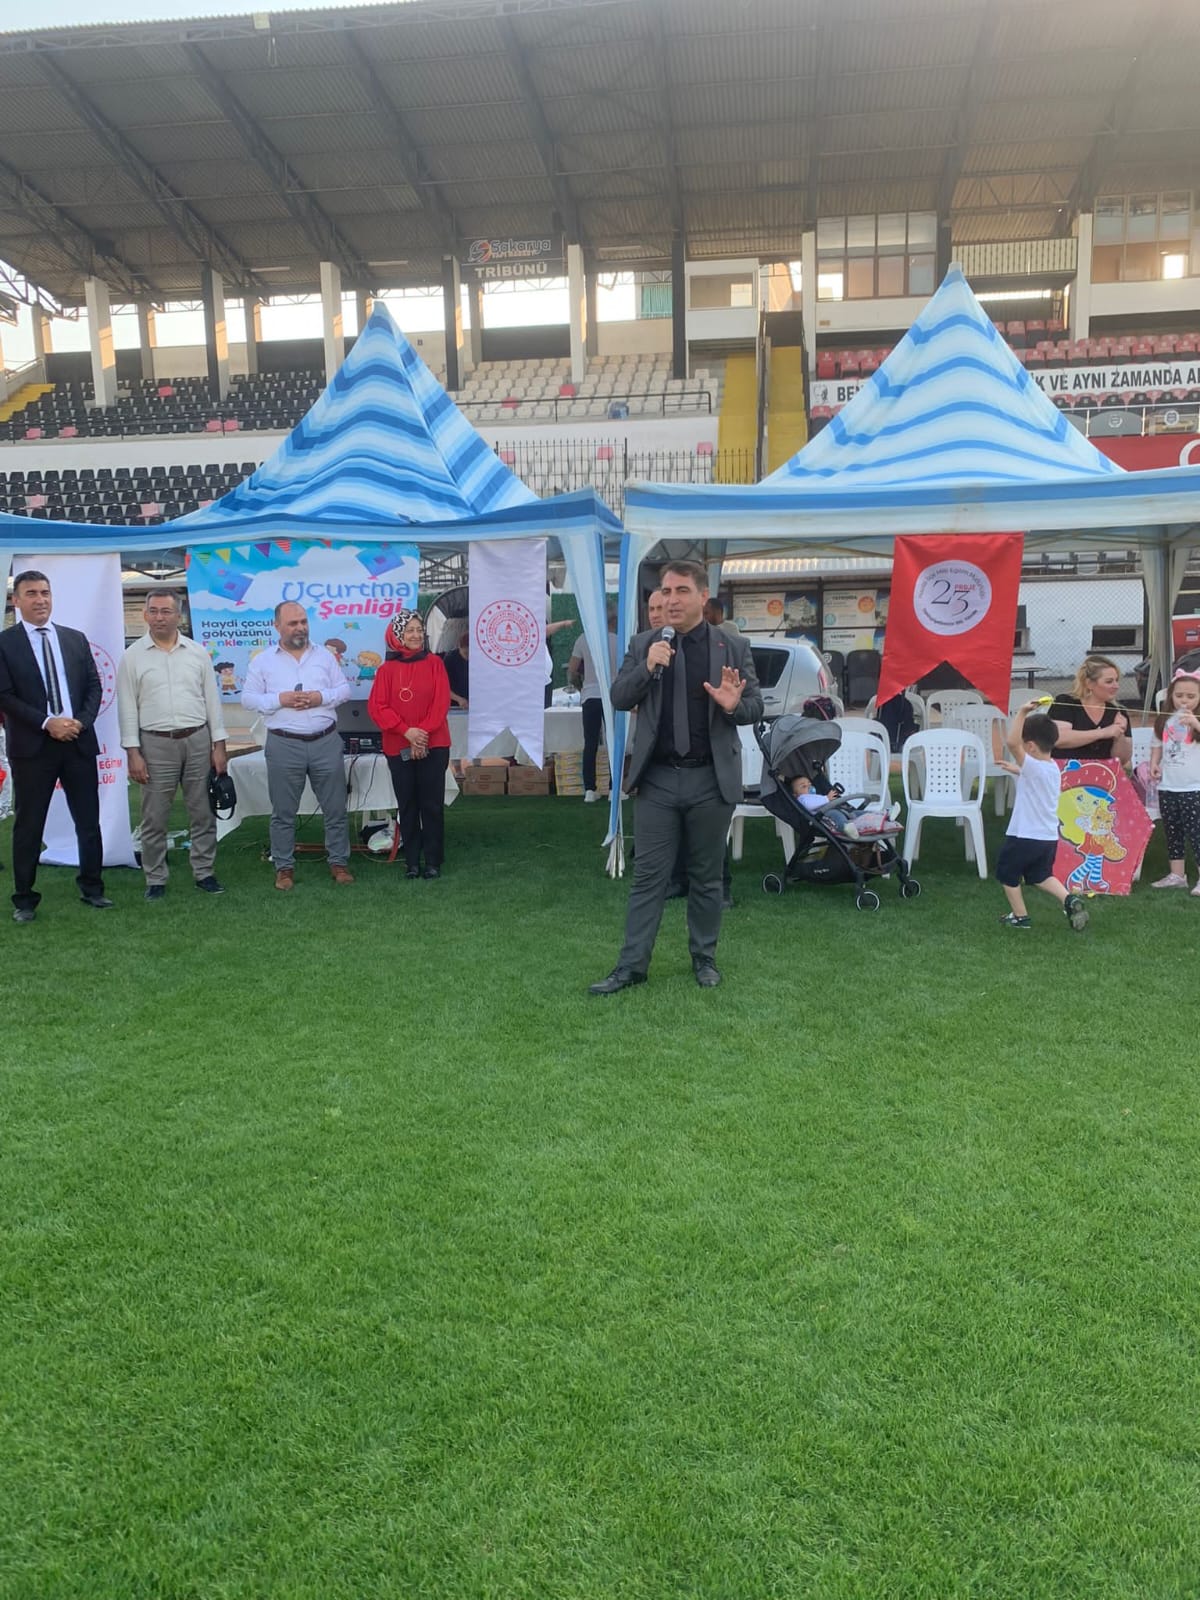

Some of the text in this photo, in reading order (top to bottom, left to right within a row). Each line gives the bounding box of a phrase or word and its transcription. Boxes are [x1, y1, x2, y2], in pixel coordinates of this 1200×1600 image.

[491, 239, 551, 254] Sakarya
[475, 263, 547, 278] TRİBÜNÜ
[1049, 374, 1069, 391] VE
[1072, 370, 1106, 389] AYNI
[1110, 368, 1183, 388] ZAMANDA
[282, 581, 411, 603] Uçurtma
[931, 579, 970, 617] 23
[319, 599, 402, 619] Şenliği
[201, 619, 238, 630] Haydi
